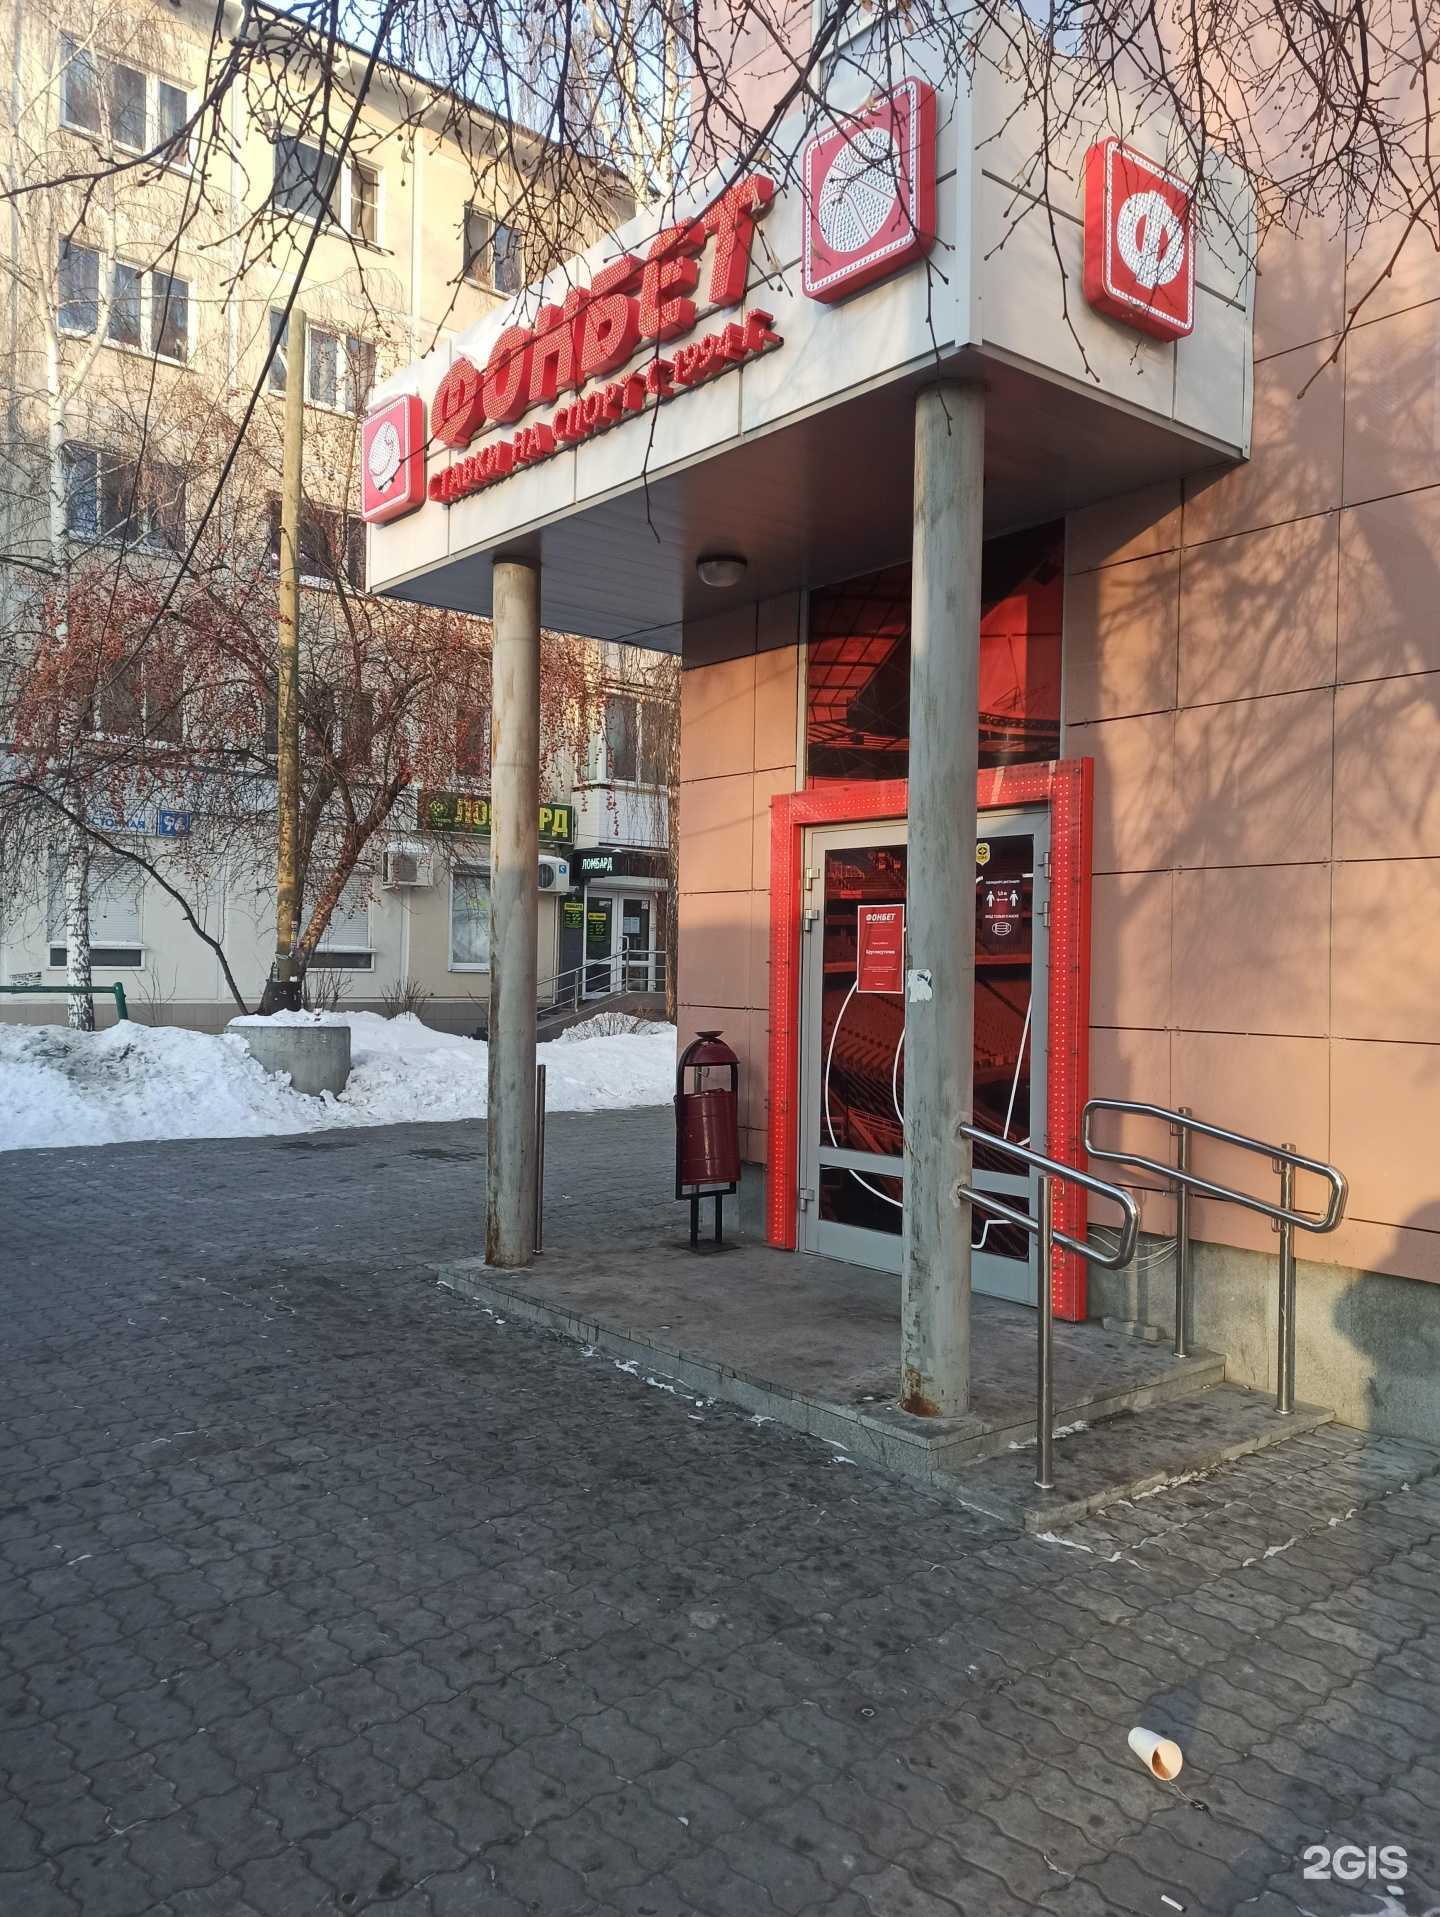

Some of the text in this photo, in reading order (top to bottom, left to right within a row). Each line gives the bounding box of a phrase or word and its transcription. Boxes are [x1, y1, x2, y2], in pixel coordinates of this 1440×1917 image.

[431, 173, 774, 448] ФОНБЕТ
[429, 440, 514, 505] СТАВКИ
[512, 422, 555, 464] НА
[553, 371, 648, 441] СПОРТ
[674, 324, 745, 386] 1994
[454, 799, 568, 838] ЛОРД
[582, 857, 613, 871] ЛОМБАРД
[866, 913, 896, 921] ФОНБЕТ
